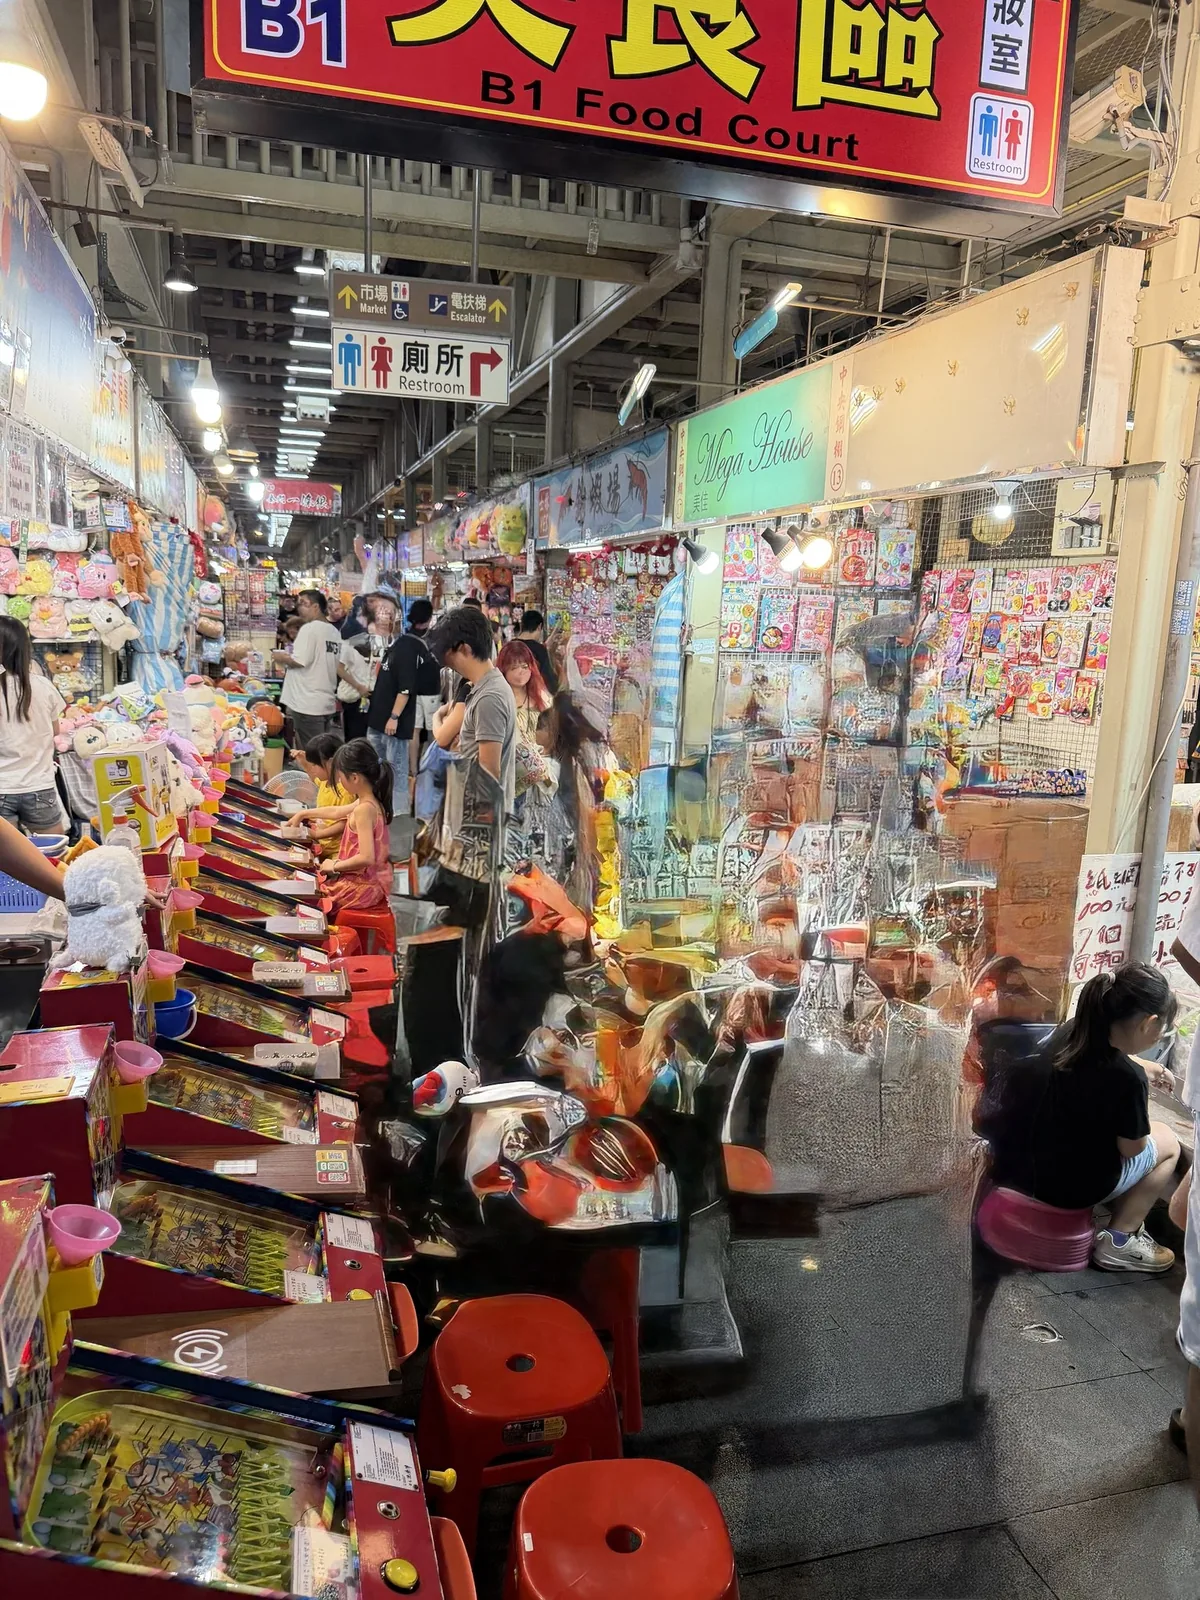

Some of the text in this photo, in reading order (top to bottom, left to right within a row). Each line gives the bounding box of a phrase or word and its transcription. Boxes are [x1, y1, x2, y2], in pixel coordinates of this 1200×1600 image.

[481, 70, 859, 161] B1 Food Court
[973, 157, 1022, 175] Restroom
[360, 284, 388, 303] 市場
[450, 292, 487, 311] 電扶梯
[360, 303, 387, 315] Market
[450, 312, 486, 323] Escalator
[401, 341, 463, 378] 廁所
[399, 376, 465, 395] Restroom
[693, 428, 745, 502] Mega
[748, 409, 813, 473] House
